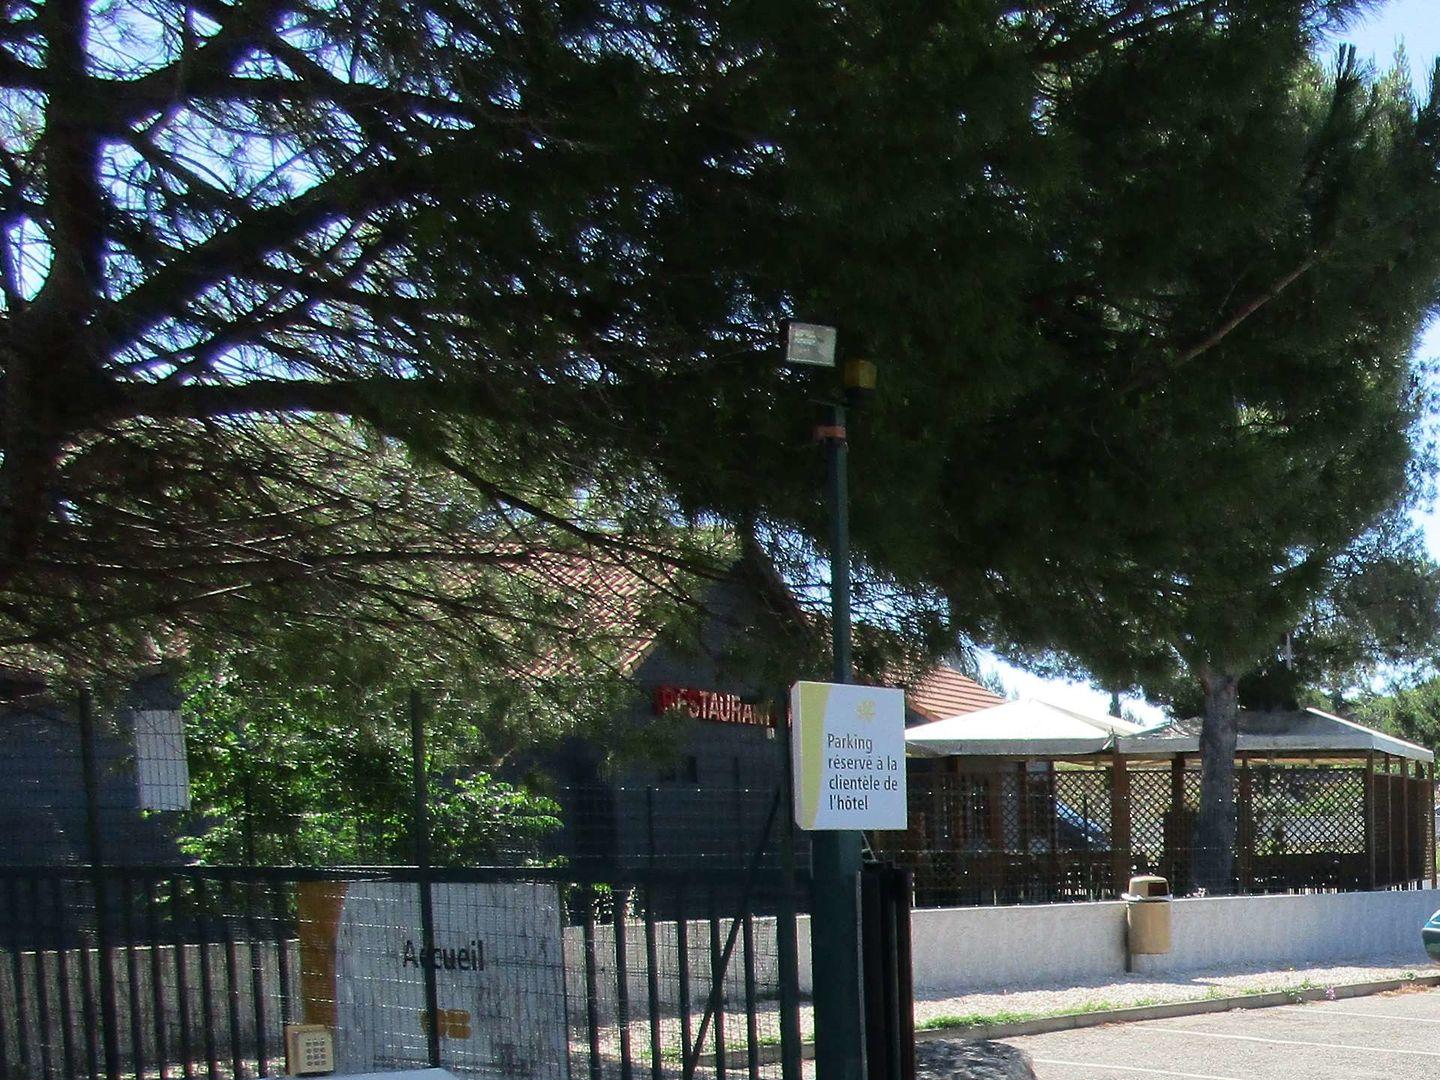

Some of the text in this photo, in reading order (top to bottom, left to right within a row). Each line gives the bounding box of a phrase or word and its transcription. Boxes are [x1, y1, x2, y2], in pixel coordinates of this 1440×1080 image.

[828, 733, 873, 754] Parking
[828, 754, 898, 771] réservé à la
[829, 774, 898, 791] clientèle de
[829, 794, 869, 811] l'hôtel
